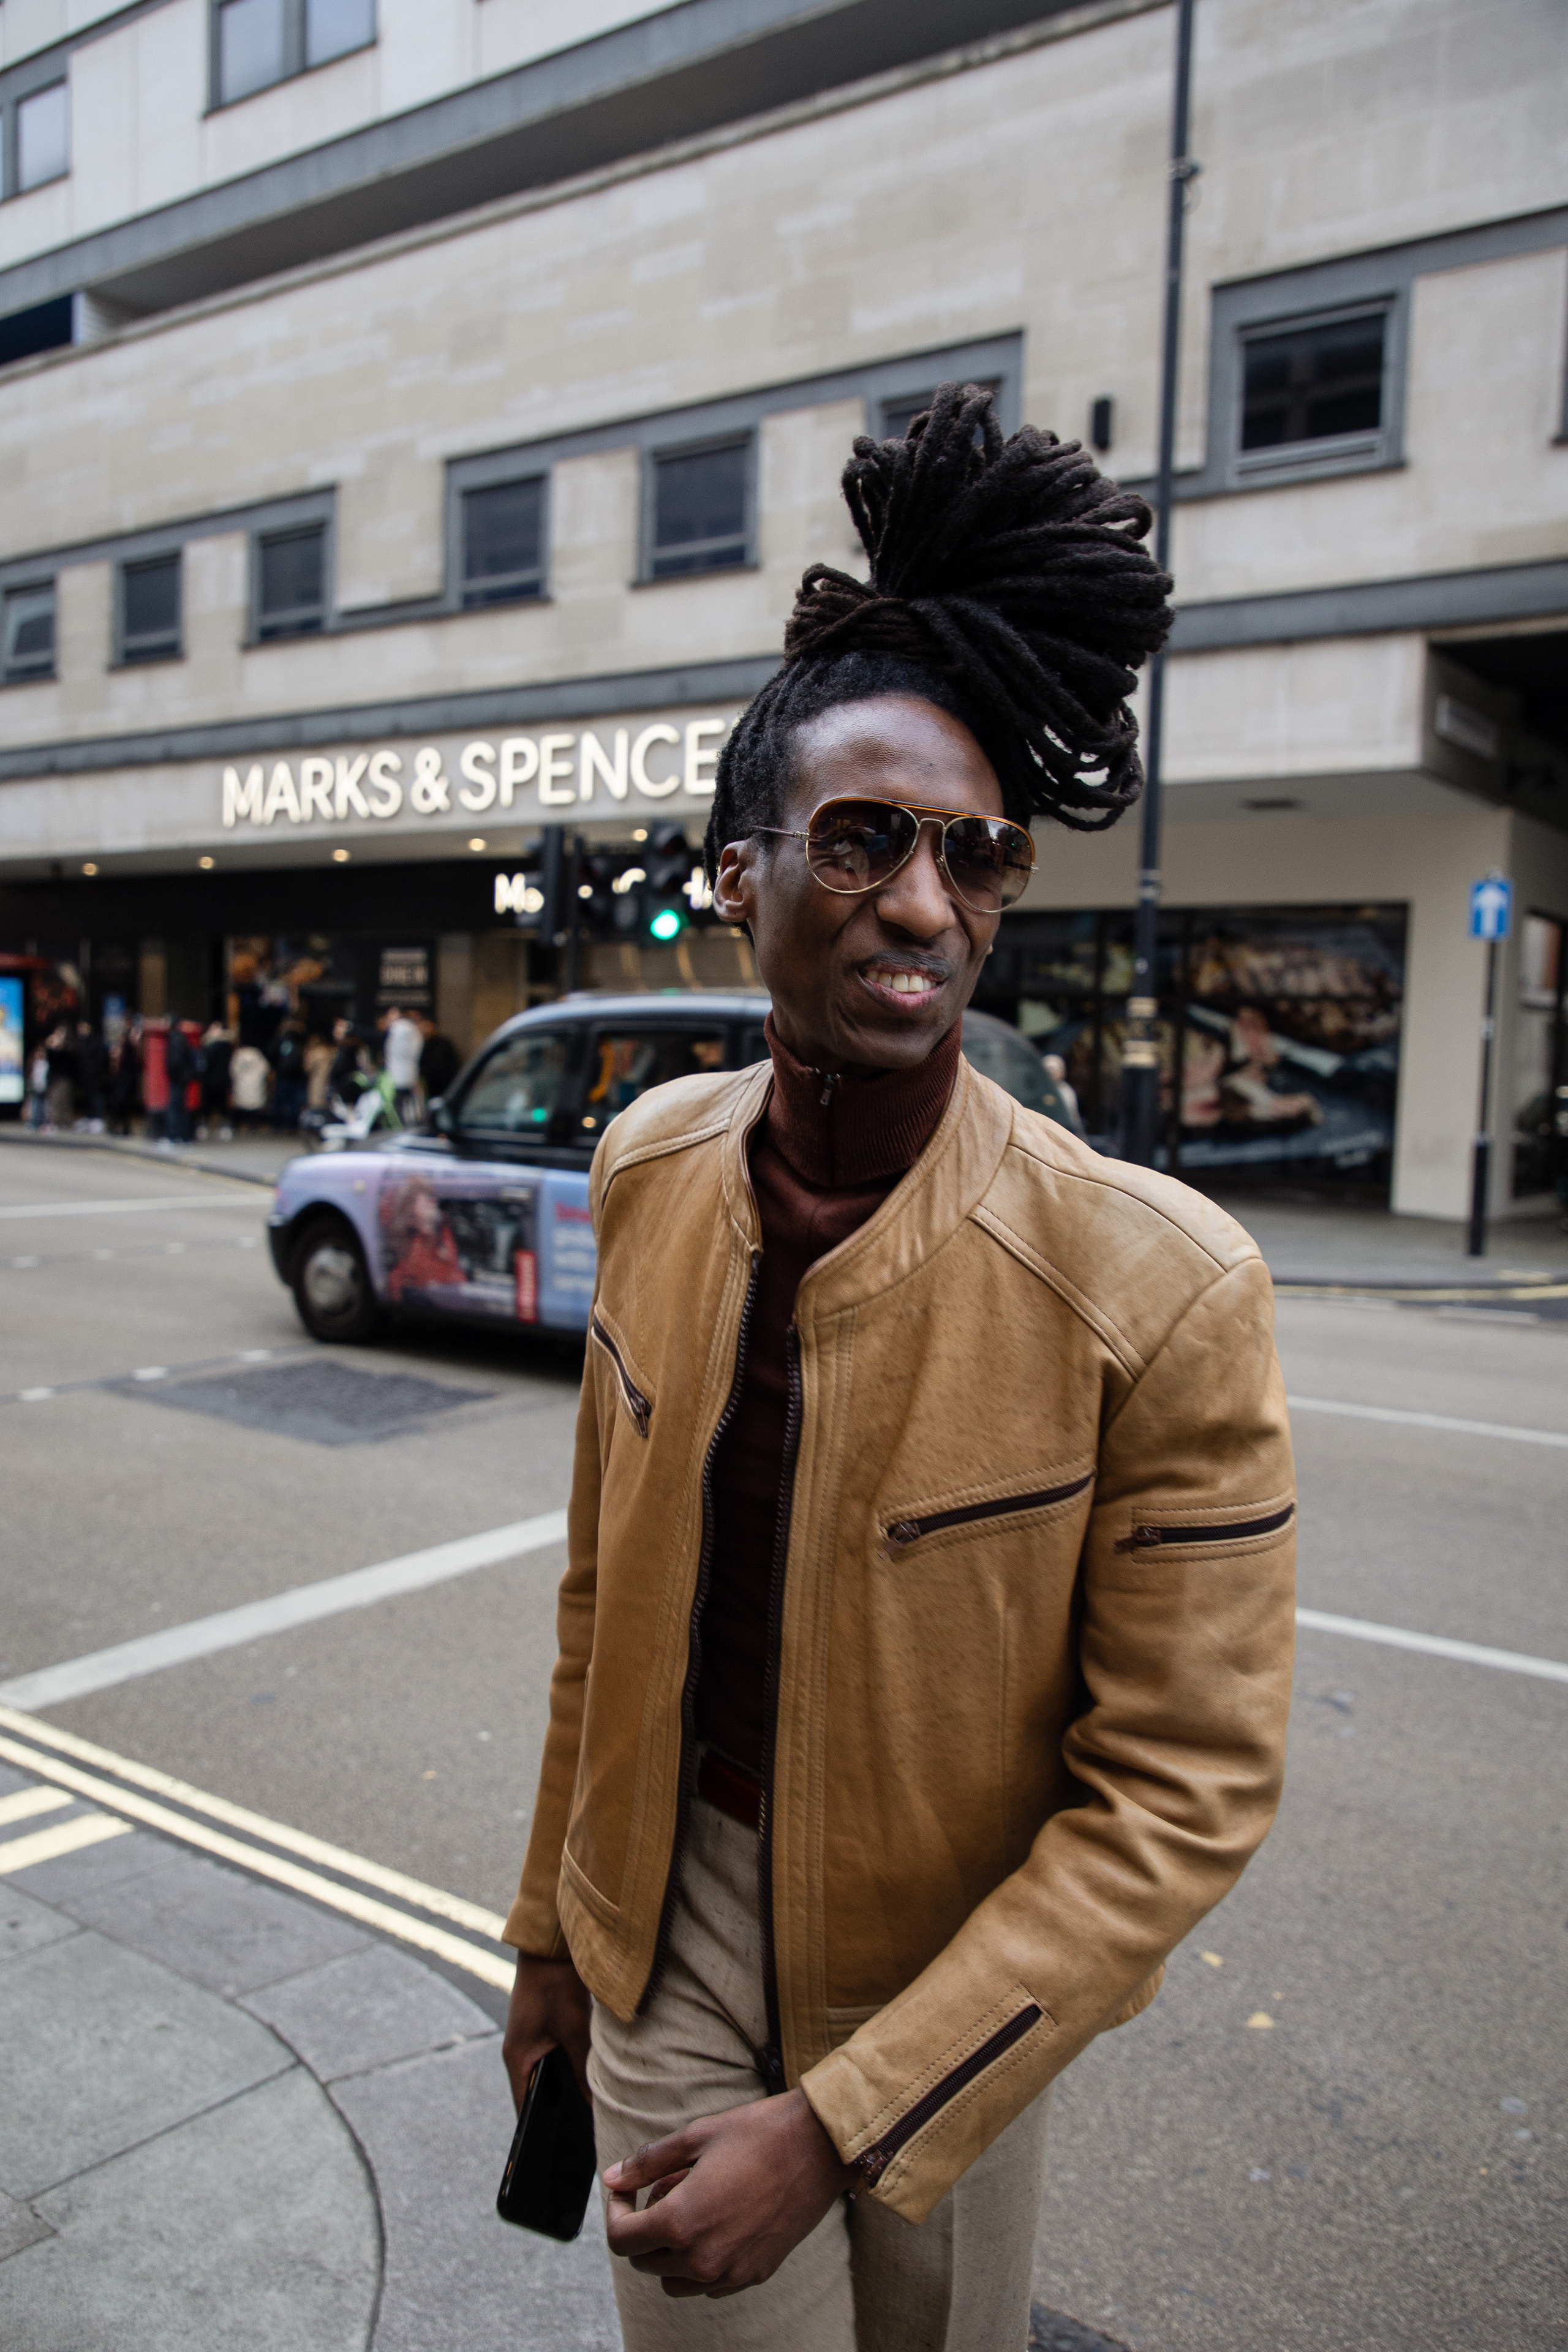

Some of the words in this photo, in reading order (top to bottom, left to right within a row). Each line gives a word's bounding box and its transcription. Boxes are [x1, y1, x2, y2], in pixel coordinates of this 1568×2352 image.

[222, 750, 403, 827] MARKS
[410, 746, 451, 813] &
[458, 718, 737, 812] SPENCE
